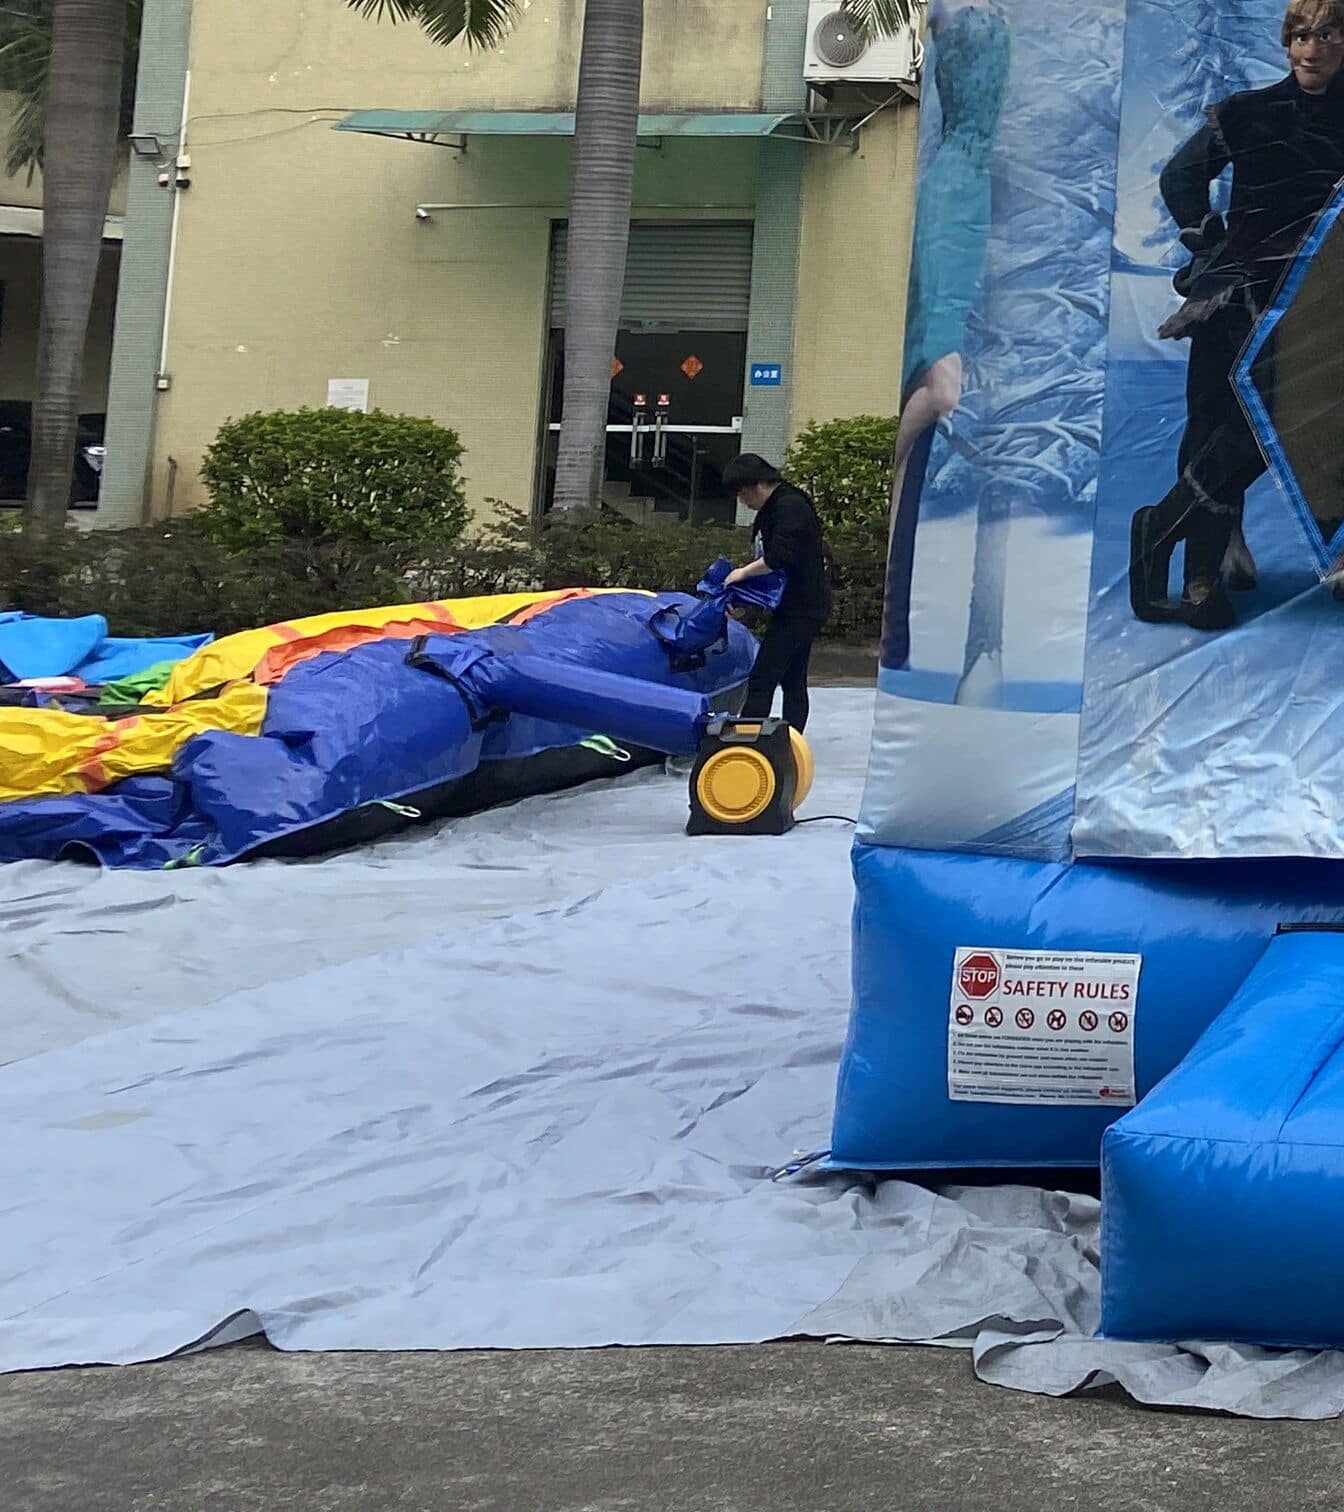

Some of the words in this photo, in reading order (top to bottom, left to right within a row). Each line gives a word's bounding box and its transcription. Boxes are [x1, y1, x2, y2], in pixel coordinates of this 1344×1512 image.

[962, 971, 997, 982] STOP
[1003, 980, 1068, 997] SAFETY
[1074, 982, 1130, 1000] RULES
